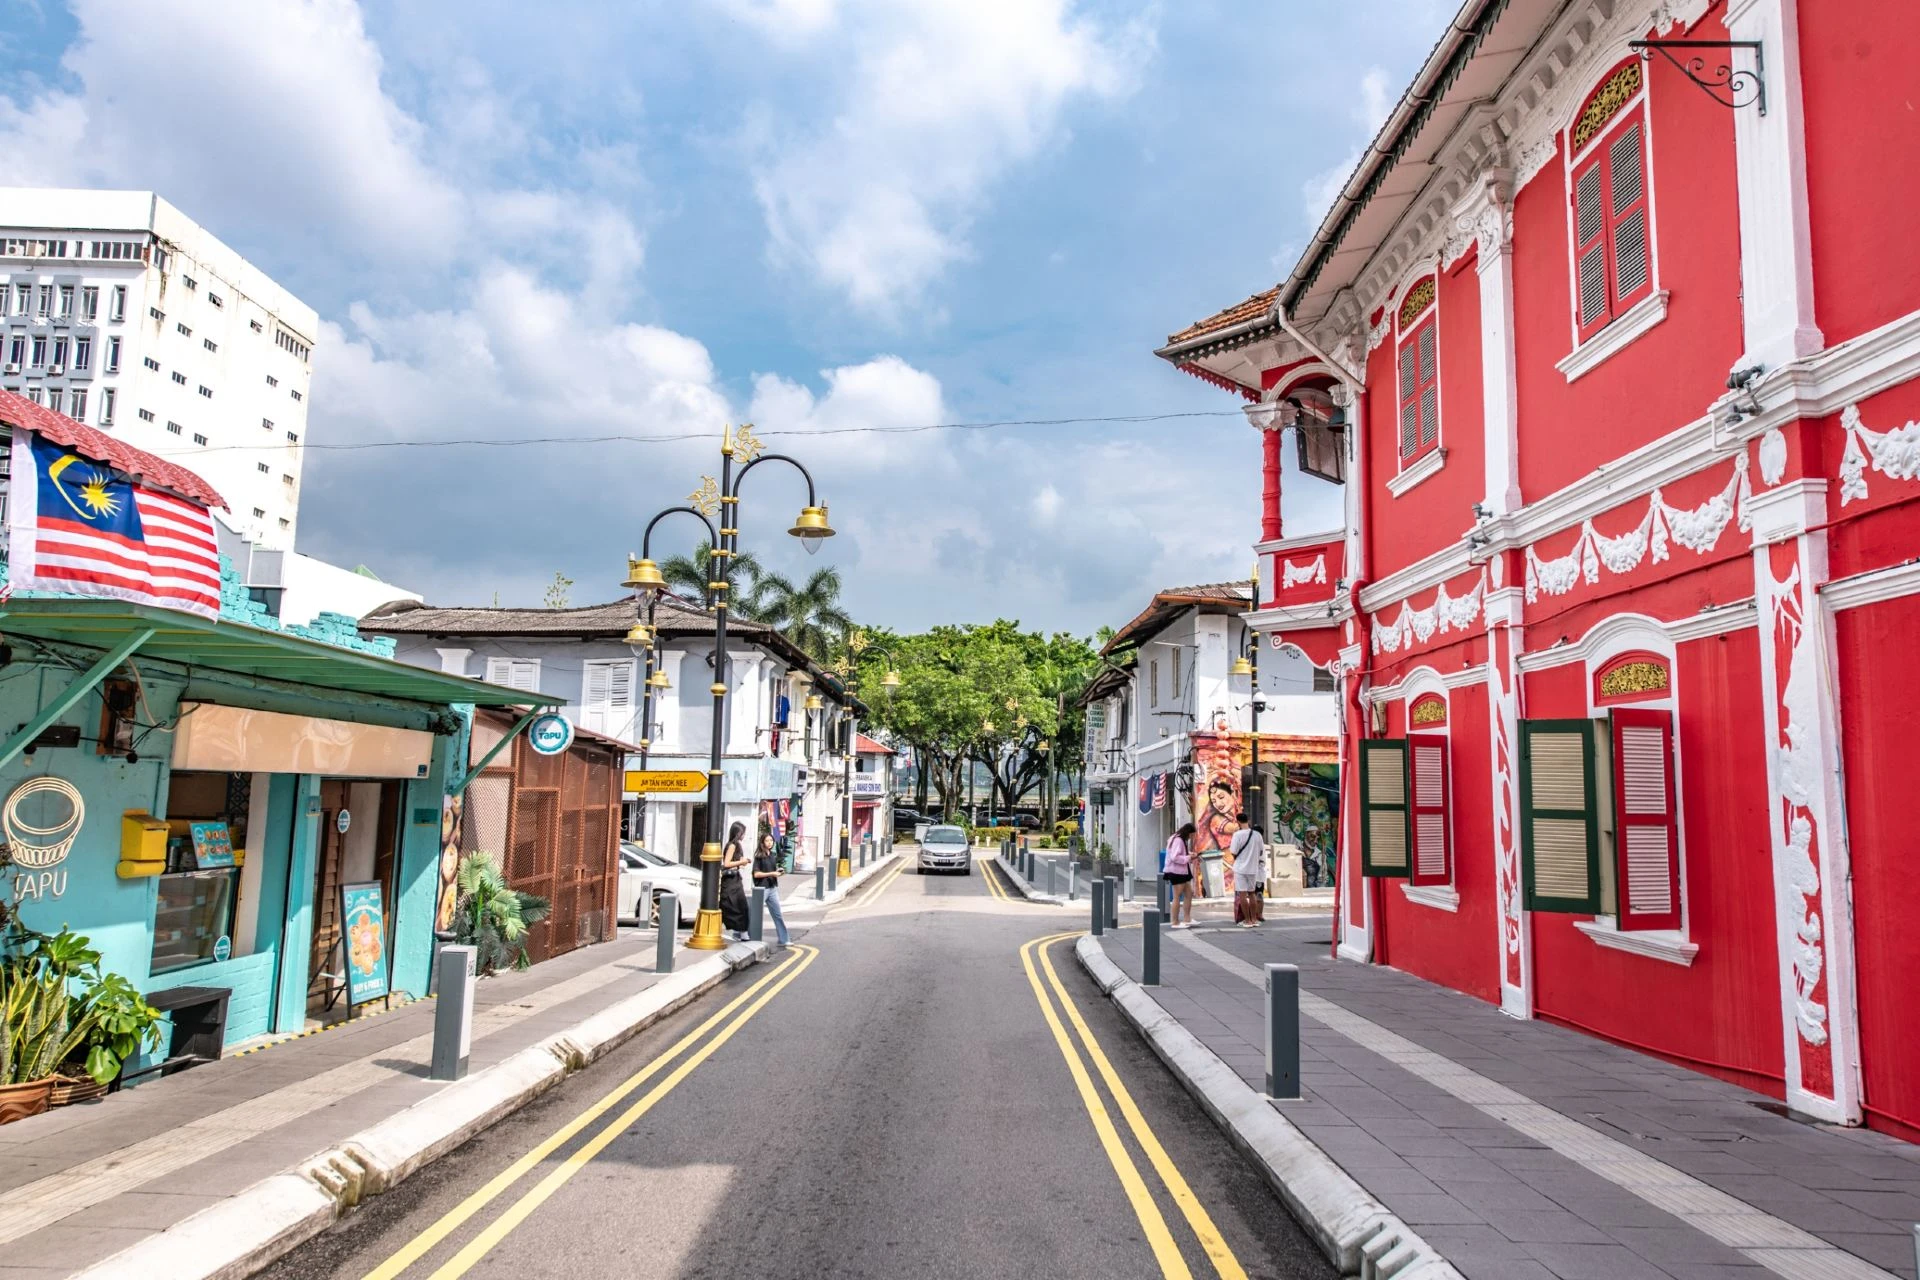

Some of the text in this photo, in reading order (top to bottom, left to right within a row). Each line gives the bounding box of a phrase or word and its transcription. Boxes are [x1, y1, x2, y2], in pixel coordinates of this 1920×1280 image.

[650, 779, 660, 787] TAN
[676, 779, 688, 787] NEE
[15, 871, 67, 900] TAPU
